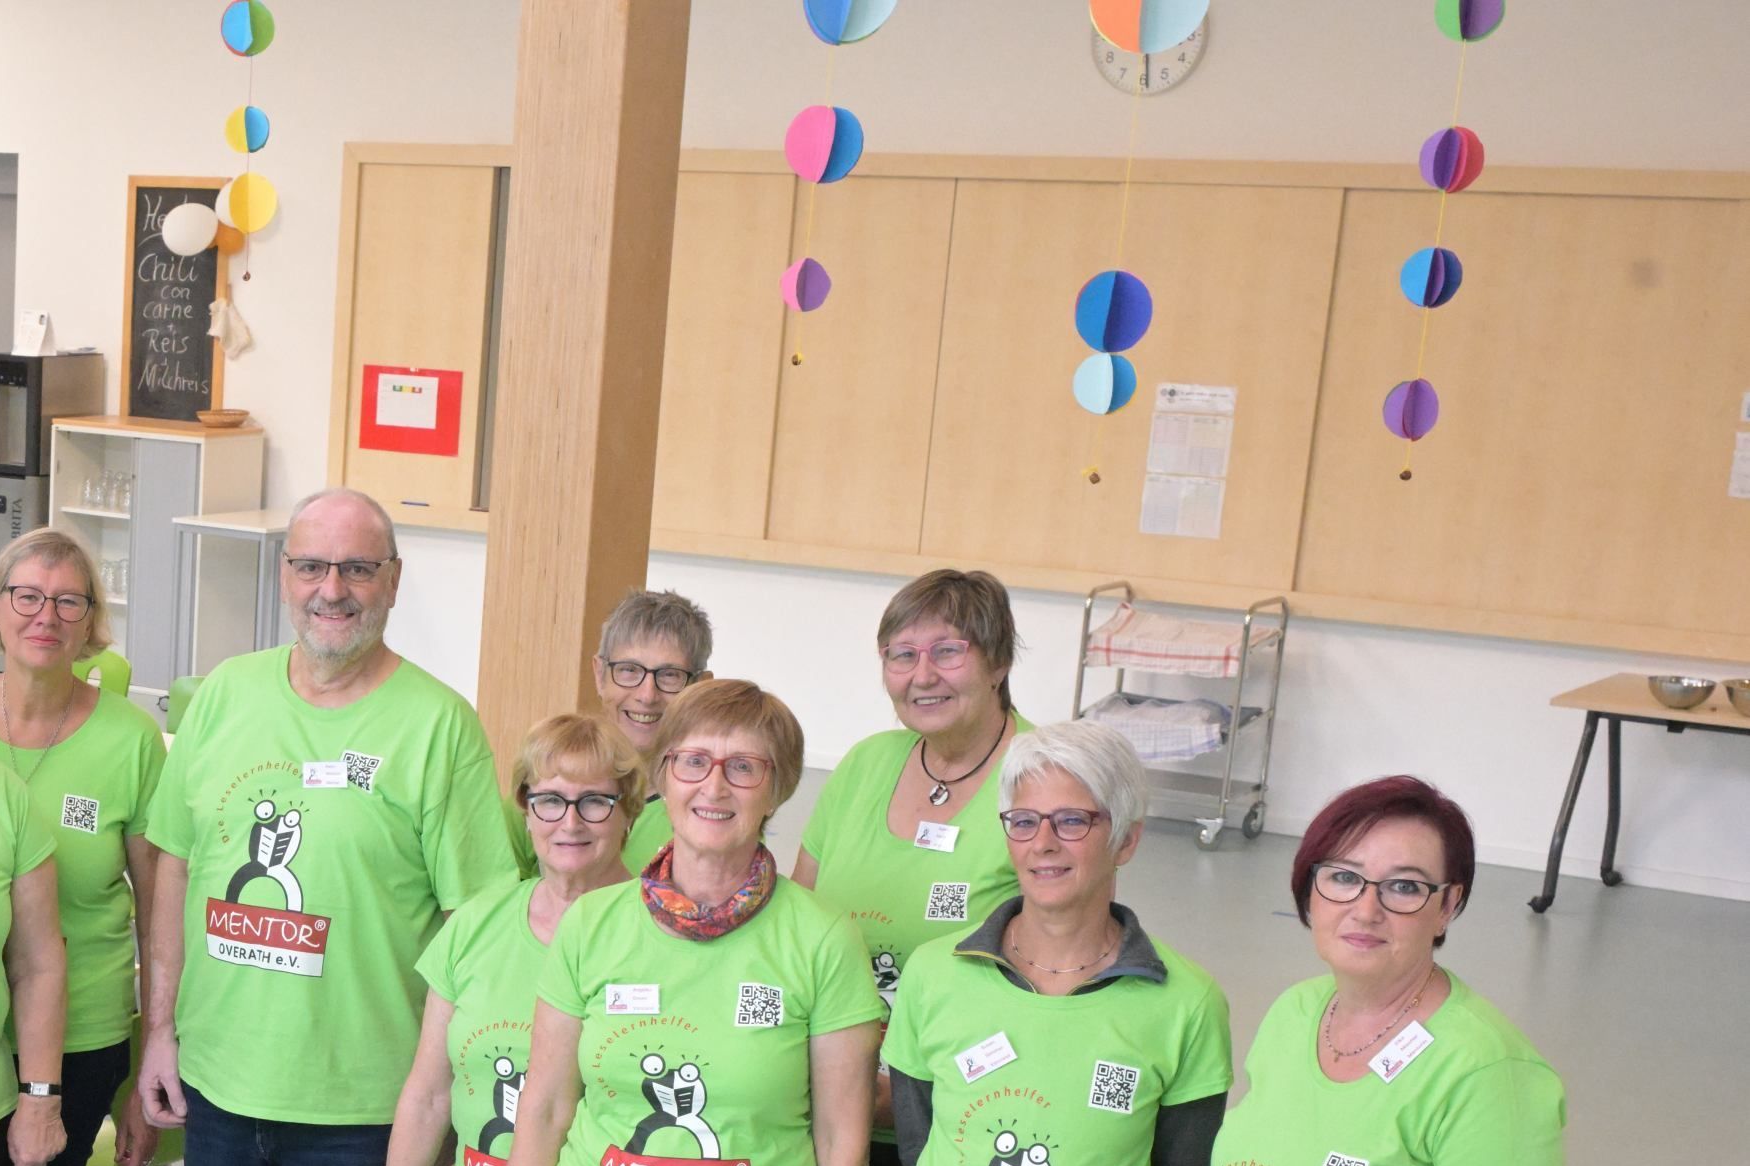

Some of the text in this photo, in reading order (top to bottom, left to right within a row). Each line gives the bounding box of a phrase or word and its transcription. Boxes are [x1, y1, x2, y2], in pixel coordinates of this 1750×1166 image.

[1105, 51, 1114, 63] 8
[1177, 52, 1186, 63] 4
[1120, 67, 1128, 79] 7
[1160, 67, 1169, 80] 5
[138, 252, 200, 282] Chili
[161, 284, 191, 300] con
[143, 301, 193, 319] carne
[142, 328, 190, 353] Reis
[137, 360, 211, 394] Milchreis
[11, 498, 23, 539] BRITA
[218, 943, 272, 964] OVERATH
[592, 1016, 698, 1068] Leselernhelfer
[953, 1086, 1051, 1143] Leselernhelfer
